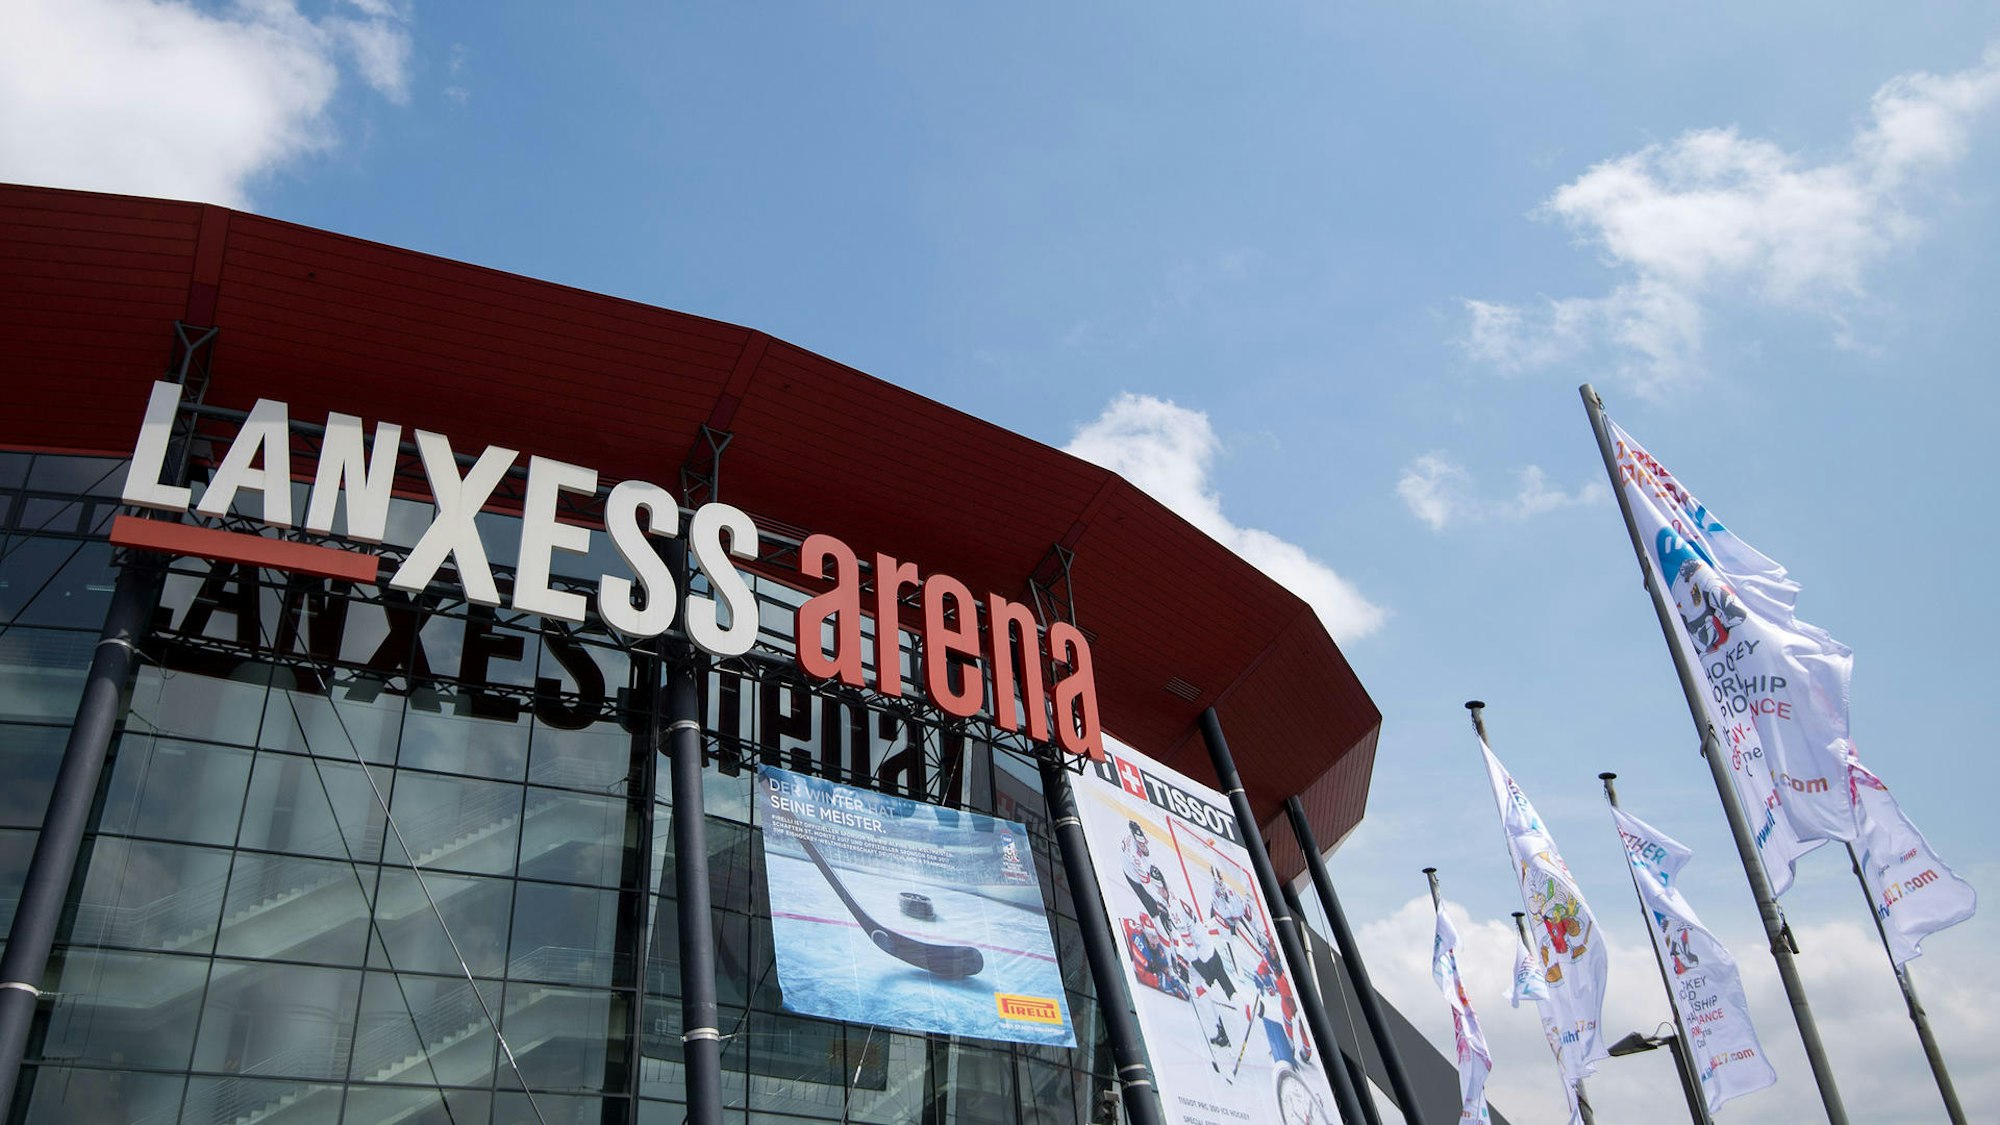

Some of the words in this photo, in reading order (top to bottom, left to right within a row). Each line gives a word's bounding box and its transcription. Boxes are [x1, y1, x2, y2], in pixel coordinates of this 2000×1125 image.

[121, 380, 759, 657] LANXESS
[796, 534, 1106, 763] arena
[769, 777, 801, 798] DER
[805, 785, 864, 813] WINTER
[867, 802, 896, 819] HAT
[770, 795, 815, 818] SEINE
[820, 806, 887, 834] MEISTER.
[1144, 774, 1236, 841] TISSOT
[1001, 998, 1056, 1019] PIRELLI
